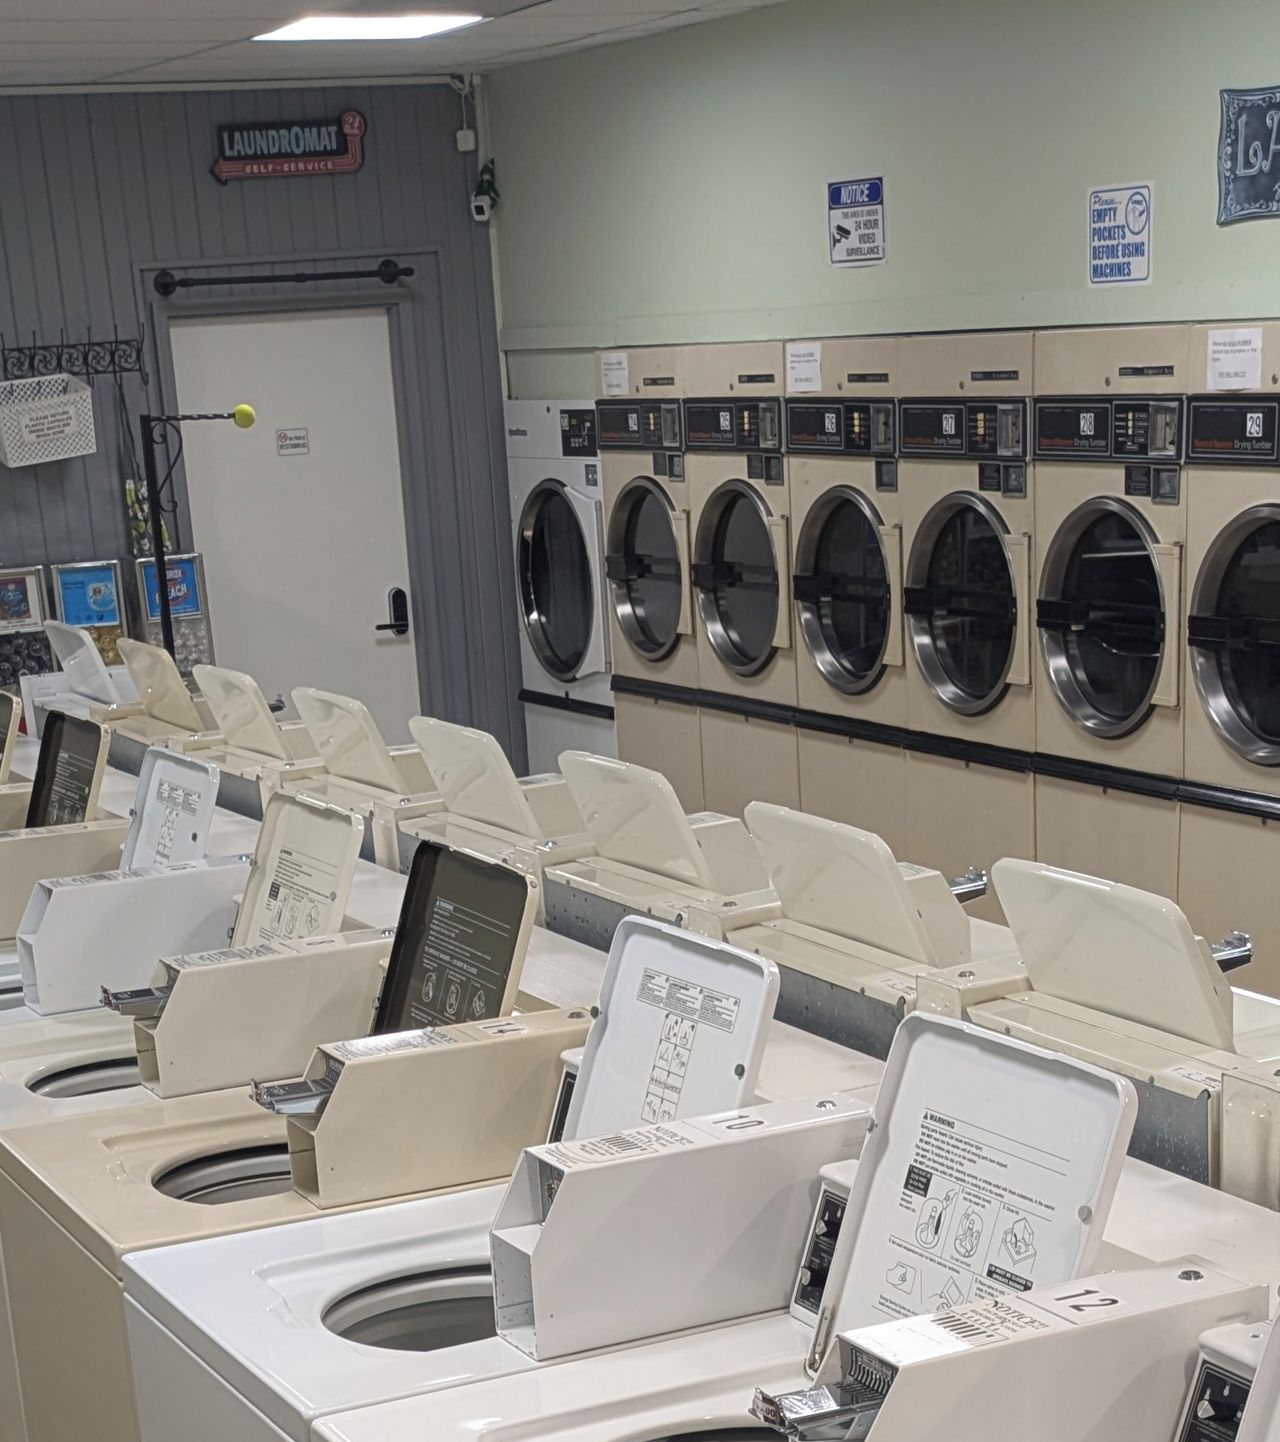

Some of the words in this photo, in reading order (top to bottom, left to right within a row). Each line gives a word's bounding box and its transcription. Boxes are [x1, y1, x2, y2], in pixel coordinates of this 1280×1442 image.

[223, 126, 337, 156] LAUNDROMAT
[245, 161, 333, 173] SELF-SERVICE
[841, 184, 870, 204] NOTICE
[1093, 207, 1117, 224] EMPTY
[855, 220, 861, 231] 24
[863, 219, 879, 230] HOUR
[1093, 224, 1126, 242] POCKETS
[859, 233, 875, 244] VIDEO
[846, 246, 880, 257] SURVEILLANCE
[1093, 244, 1119, 260] BEFORE
[1122, 241, 1145, 258] USING
[1093, 261, 1131, 279] MACHINES
[825, 414, 836, 432] 26
[943, 415, 954, 434] 27
[1081, 414, 1094, 434] 28
[1248, 415, 1261, 436] 29
[1074, 437, 1089, 448] Drying
[1234, 440, 1251, 451] Drying
[1252, 440, 1272, 449] Tumbler
[712, 1115, 765, 1131] 10
[1054, 1289, 1120, 1312] 12
